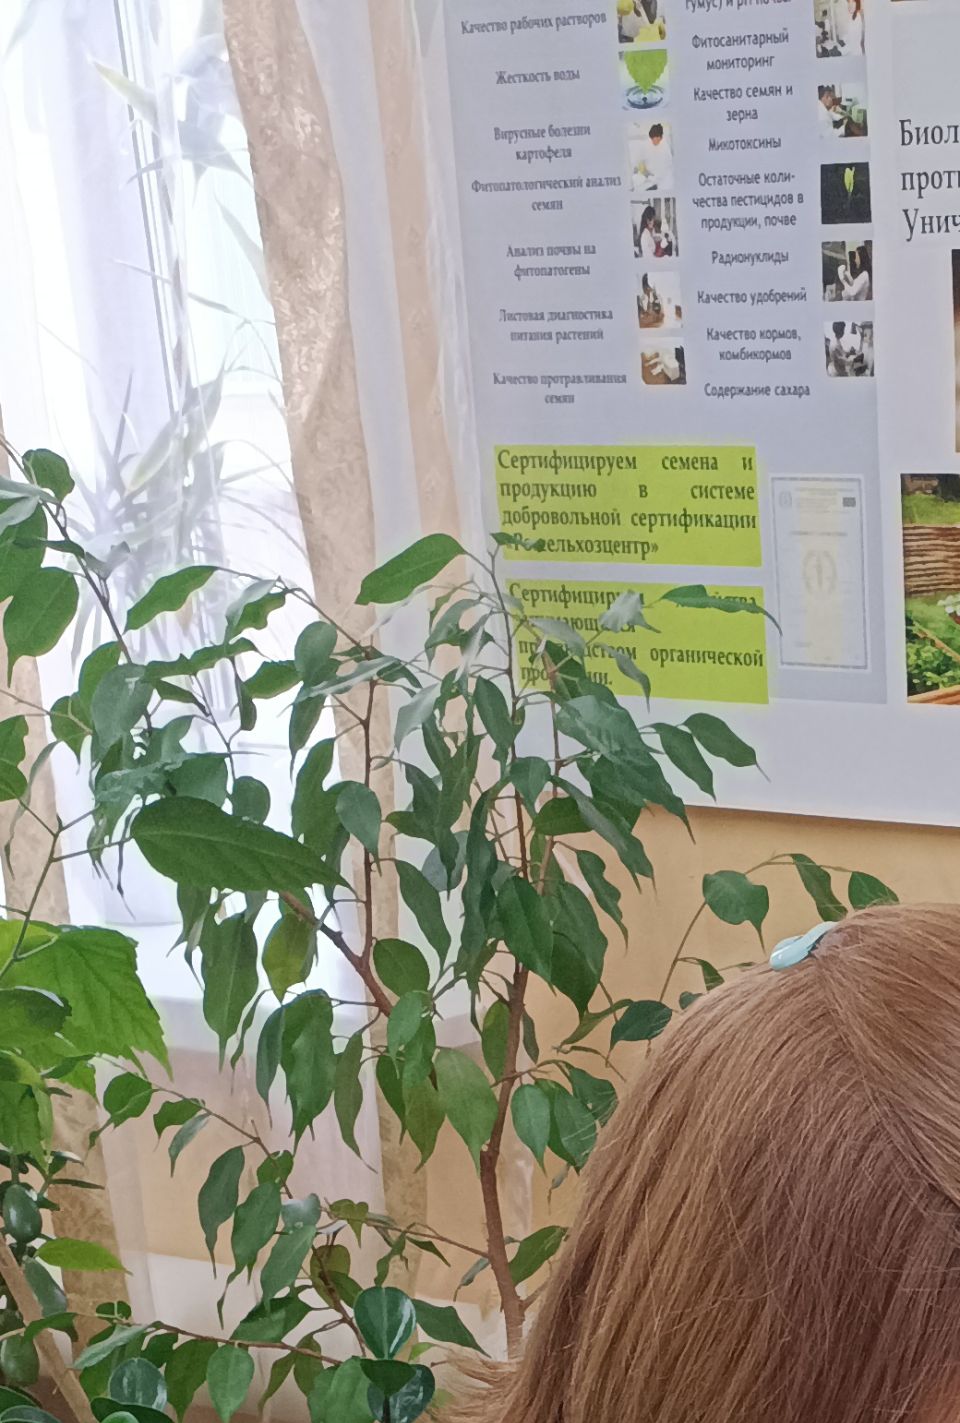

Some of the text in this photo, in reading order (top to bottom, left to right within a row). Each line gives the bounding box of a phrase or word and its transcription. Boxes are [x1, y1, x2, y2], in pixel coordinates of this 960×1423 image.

[461, 12, 607, 35] Качество рабочих растворов
[691, 27, 789, 49] Фитосанитарный
[706, 56, 775, 72] мониторинг
[495, 68, 580, 84] Жесткость воды
[693, 85, 794, 102] Качество семян и
[726, 109, 758, 124] зерна
[494, 124, 591, 145] Вирусные болезни
[708, 138, 781, 152] Микотоксины
[515, 146, 572, 163] картофеля
[471, 175, 622, 193] Фитопатологический анализ
[698, 172, 796, 187] Остаточные коли-
[531, 199, 563, 211] семян
[692, 193, 804, 208] чества пестицидов в
[701, 215, 797, 232] продукции, почве
[506, 244, 596, 258] Анализ почвы на
[711, 250, 789, 266] Радионуклиды
[514, 264, 591, 281] фитопатогены
[697, 287, 807, 306] Качество удобрений
[707, 328, 802, 343] Качество кормов,
[719, 347, 792, 363] комбикормов
[493, 372, 538, 385] Качество
[704, 383, 810, 399] Содержание сахара
[497, 449, 753, 476] Сертифицируем семена и
[500, 481, 755, 503] продукцию в системе
[502, 506, 757, 533] добровольной сертификации
[650, 646, 764, 668] органической
